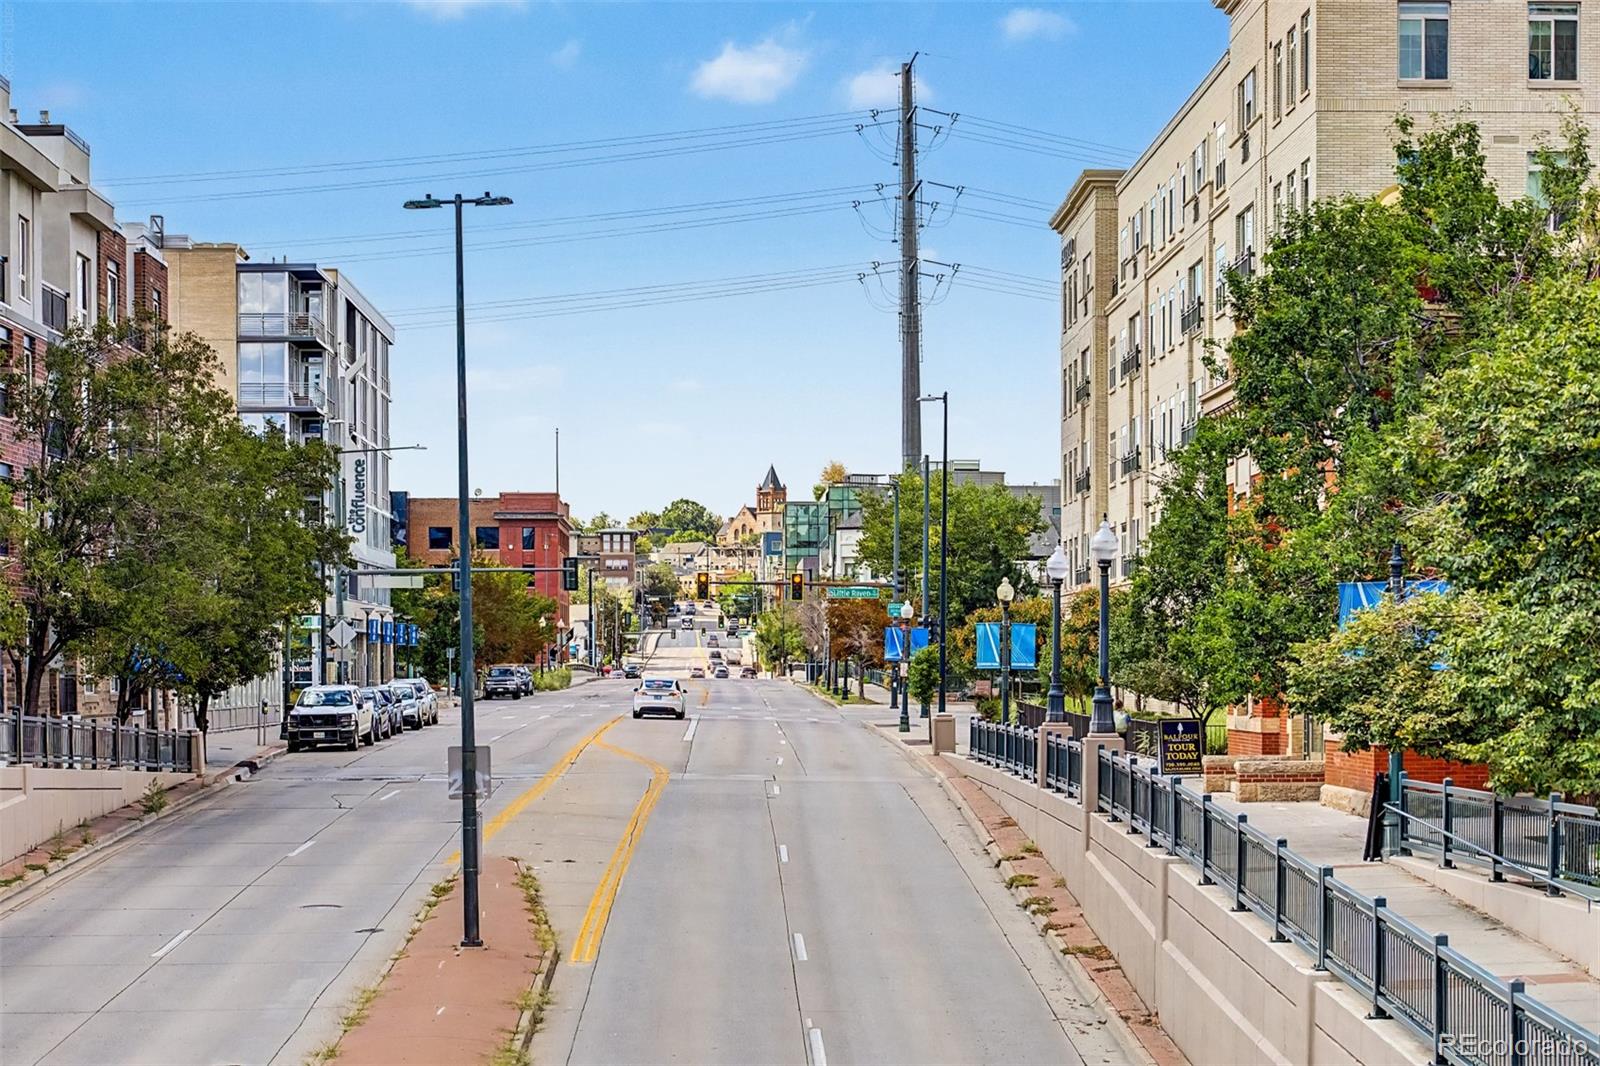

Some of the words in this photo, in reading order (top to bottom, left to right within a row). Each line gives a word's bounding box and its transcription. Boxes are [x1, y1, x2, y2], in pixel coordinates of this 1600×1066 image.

[351, 458, 366, 533] Confluence
[833, 589, 850, 597] Little
[1168, 743, 1196, 751] TOUR
[1165, 752, 1199, 760] TODAY
